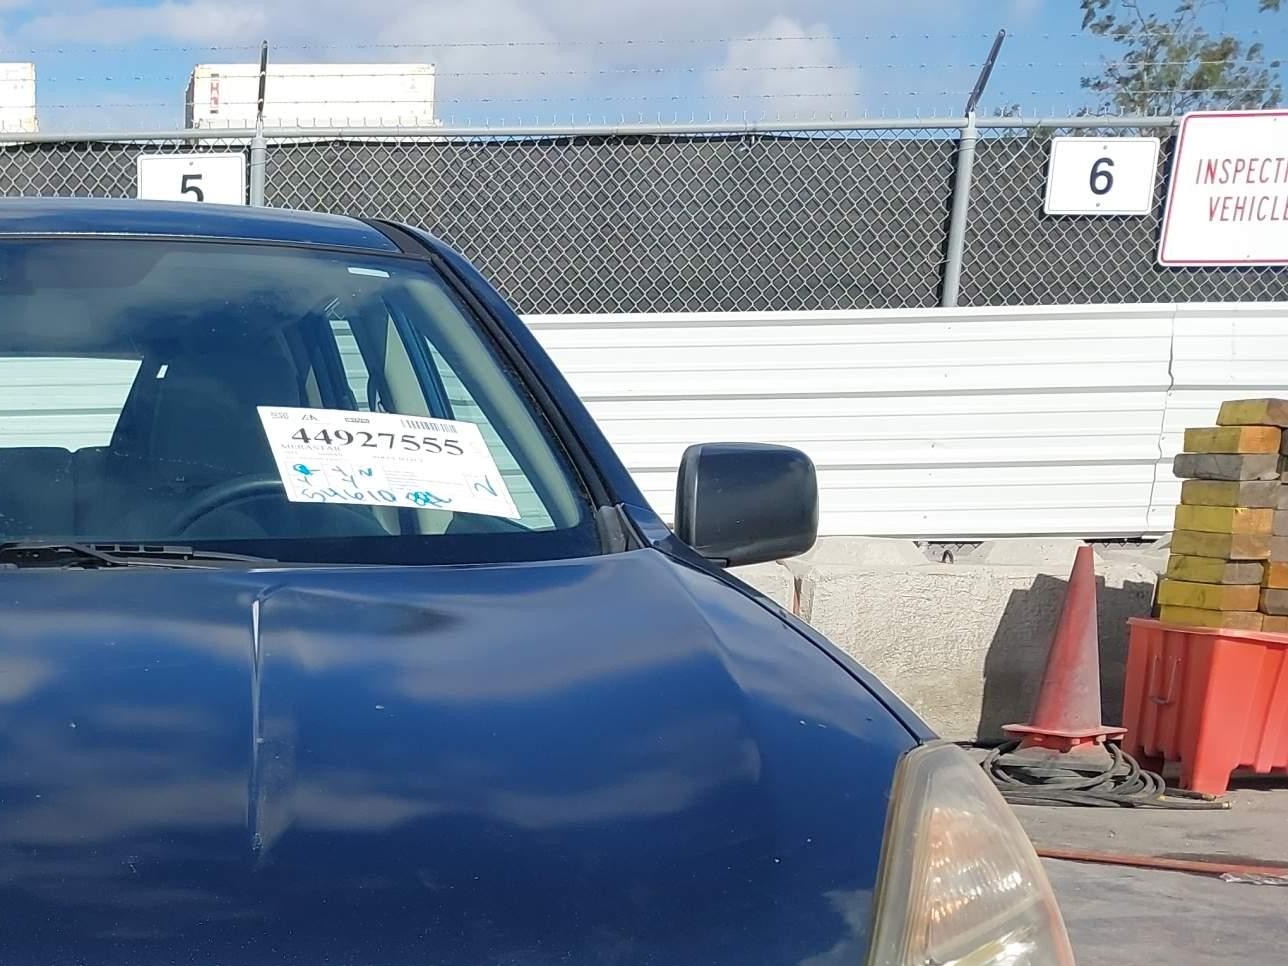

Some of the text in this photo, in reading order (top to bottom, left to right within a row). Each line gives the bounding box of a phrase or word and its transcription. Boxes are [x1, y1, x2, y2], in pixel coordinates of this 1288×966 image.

[181, 174, 204, 202] 5
[1090, 157, 1115, 195] 6
[291, 427, 464, 455] 44927555
